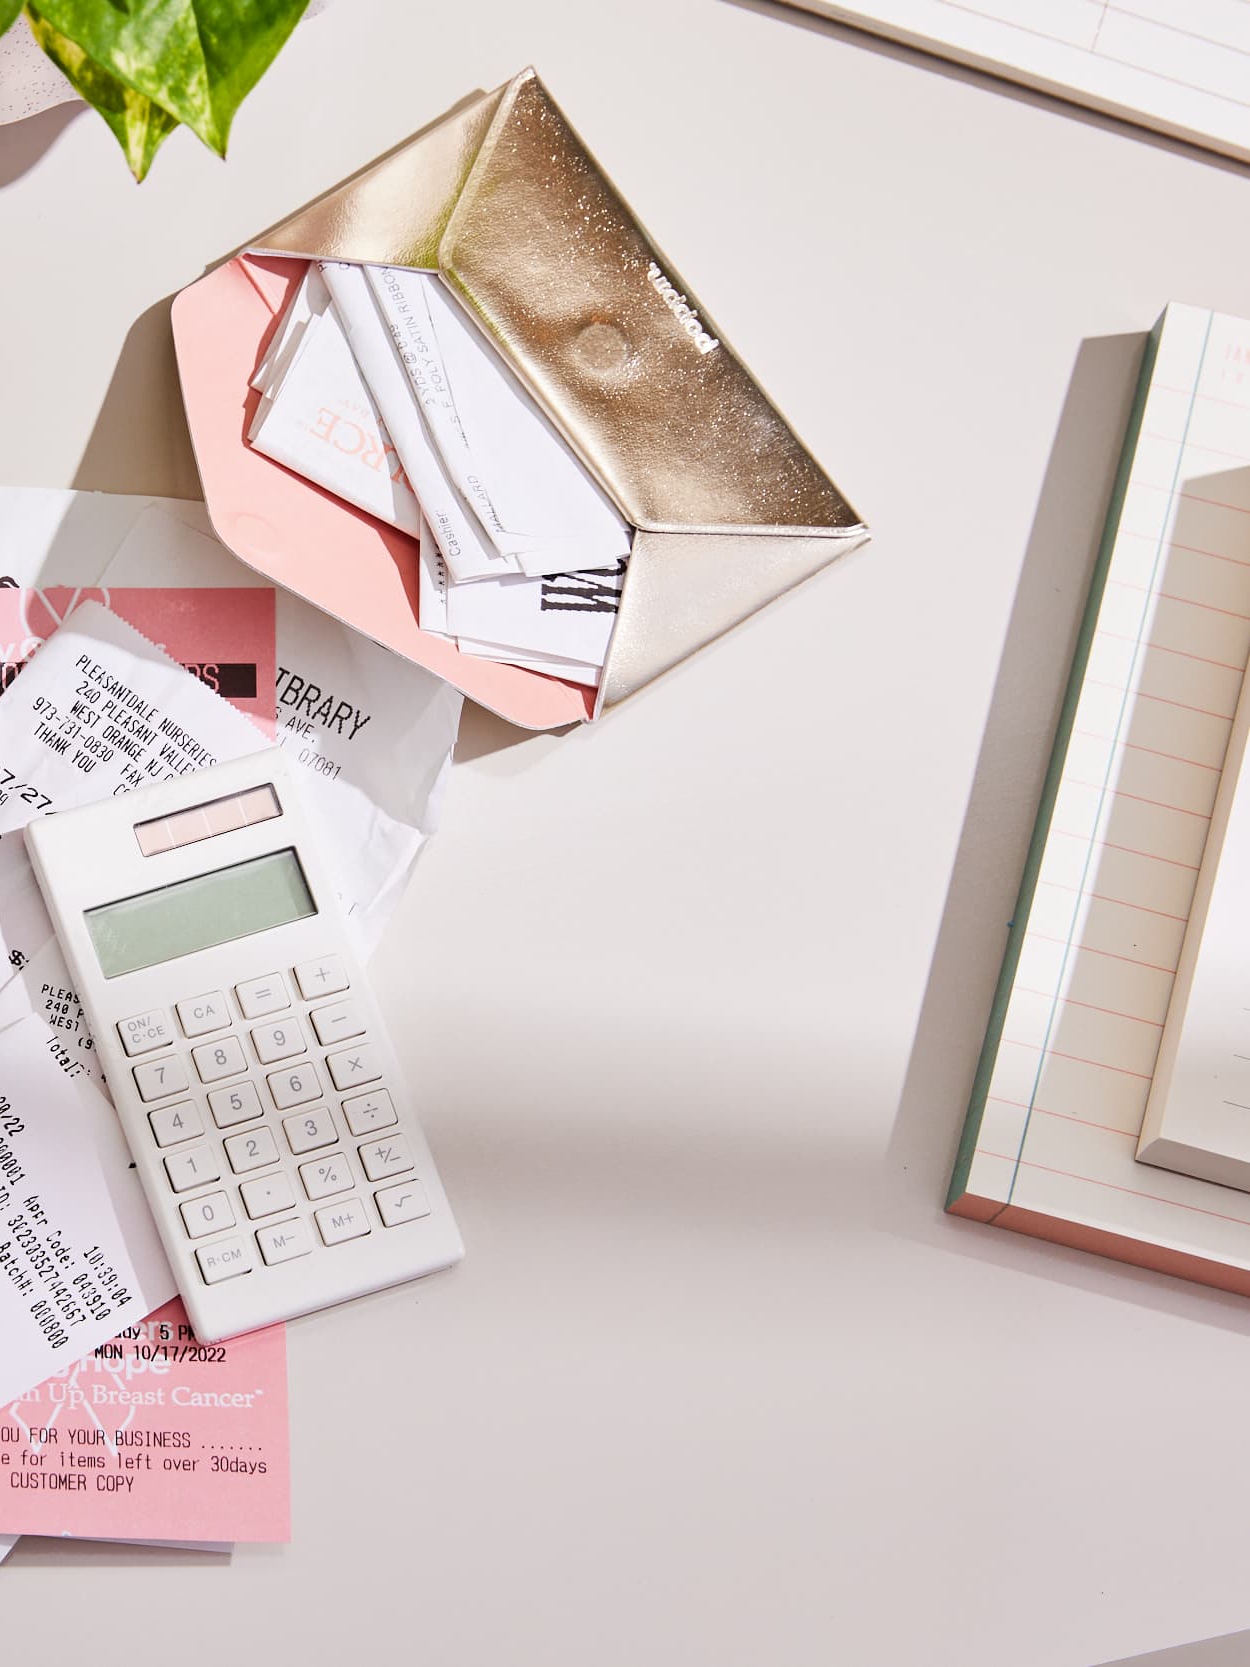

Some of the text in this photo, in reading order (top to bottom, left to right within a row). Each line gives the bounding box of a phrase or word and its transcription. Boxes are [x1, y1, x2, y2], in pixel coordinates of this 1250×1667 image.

[404, 315, 428, 353] SATIN
[76, 654, 159, 722] PLEASANTDALE
[158, 718, 217, 766] NURSERIES
[76, 681, 101, 703] 240
[101, 700, 159, 745] PLEASANT
[70, 700, 164, 777] WEST ORANGE NJ
[285, 716, 315, 743] AVE.
[33, 696, 144, 787] 973-731-0830 FAX
[33, 722, 97, 773] THANK YOU
[298, 748, 342, 781] 07081
[45, 999, 69, 1014] 240
[193, 1005, 215, 1019] CA
[273, 1030, 286, 1046] 9
[214, 1049, 227, 1065] 8
[154, 1067, 165, 1084] 7
[289, 1075, 302, 1092] 6
[230, 1094, 243, 1111] 5
[172, 1113, 184, 1129] 4
[305, 1120, 318, 1136] 3
[246, 1140, 260, 1157] 2
[187, 1157, 197, 1173] 1
[202, 1205, 214, 1221] 0
[332, 1213, 354, 1229] M+
[46, 1230, 75, 1270] Code:
[72, 1273, 111, 1321] 043910
[84, 1246, 133, 1308] 10:39:04
[30, 1300, 69, 1349] 000800
[160, 1325, 170, 1340] 5
[94, 1344, 226, 1363] MON 10/17/2022
[48, 1383, 84, 1409] Up
[91, 1385, 166, 1407] Breast
[29, 1428, 58, 1444] FOR
[68, 1429, 105, 1446] YOUR
[115, 1430, 191, 1448] BUSINESS
[21, 1451, 47, 1467] for
[61, 1452, 105, 1469] items
[117, 1453, 151, 1471] left
[163, 1459, 200, 1472] over
[211, 1456, 267, 1475] 30days
[10, 1472, 134, 1492] CUSTOMER COPY
